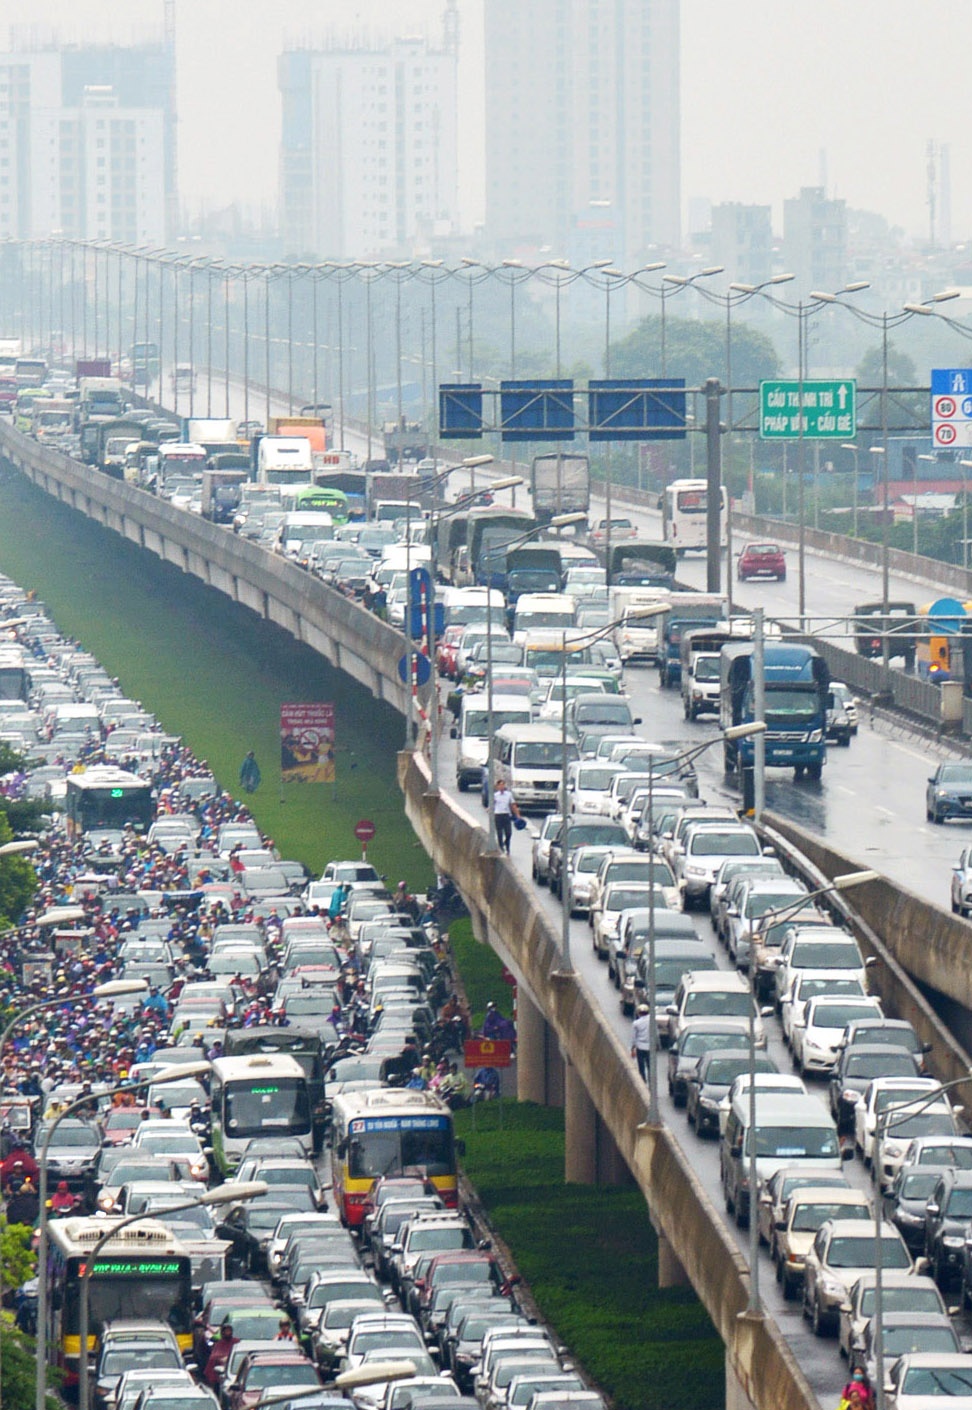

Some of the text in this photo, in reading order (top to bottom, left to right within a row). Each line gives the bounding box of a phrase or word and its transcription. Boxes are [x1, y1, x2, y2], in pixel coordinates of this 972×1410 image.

[940, 401, 951, 413] 80
[941, 428, 951, 440] 70
[353, 1121, 364, 1131] 27
